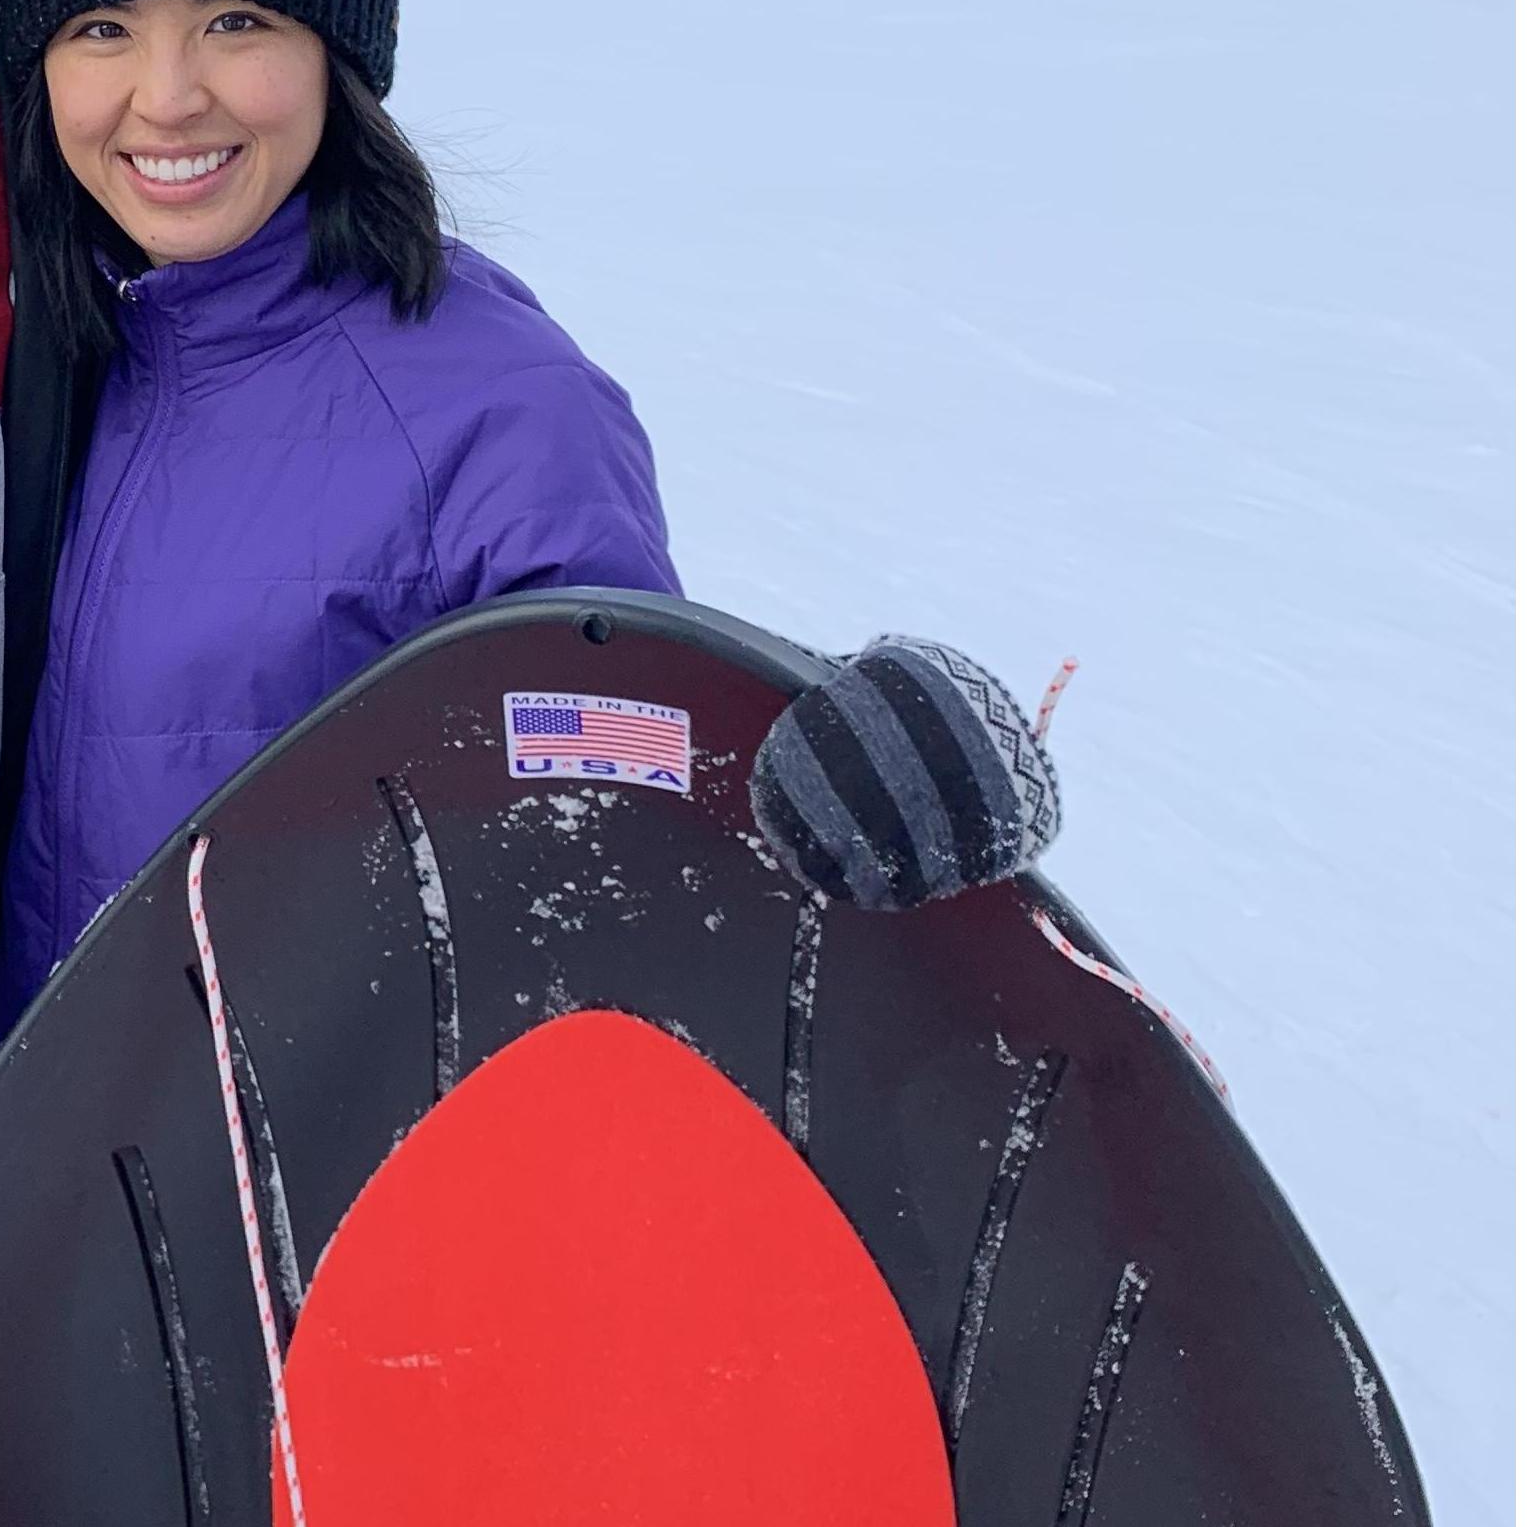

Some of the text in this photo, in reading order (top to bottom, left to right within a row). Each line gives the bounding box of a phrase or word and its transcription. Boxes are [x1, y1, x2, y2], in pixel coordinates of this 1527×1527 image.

[511, 696, 684, 720] MADE IN THE
